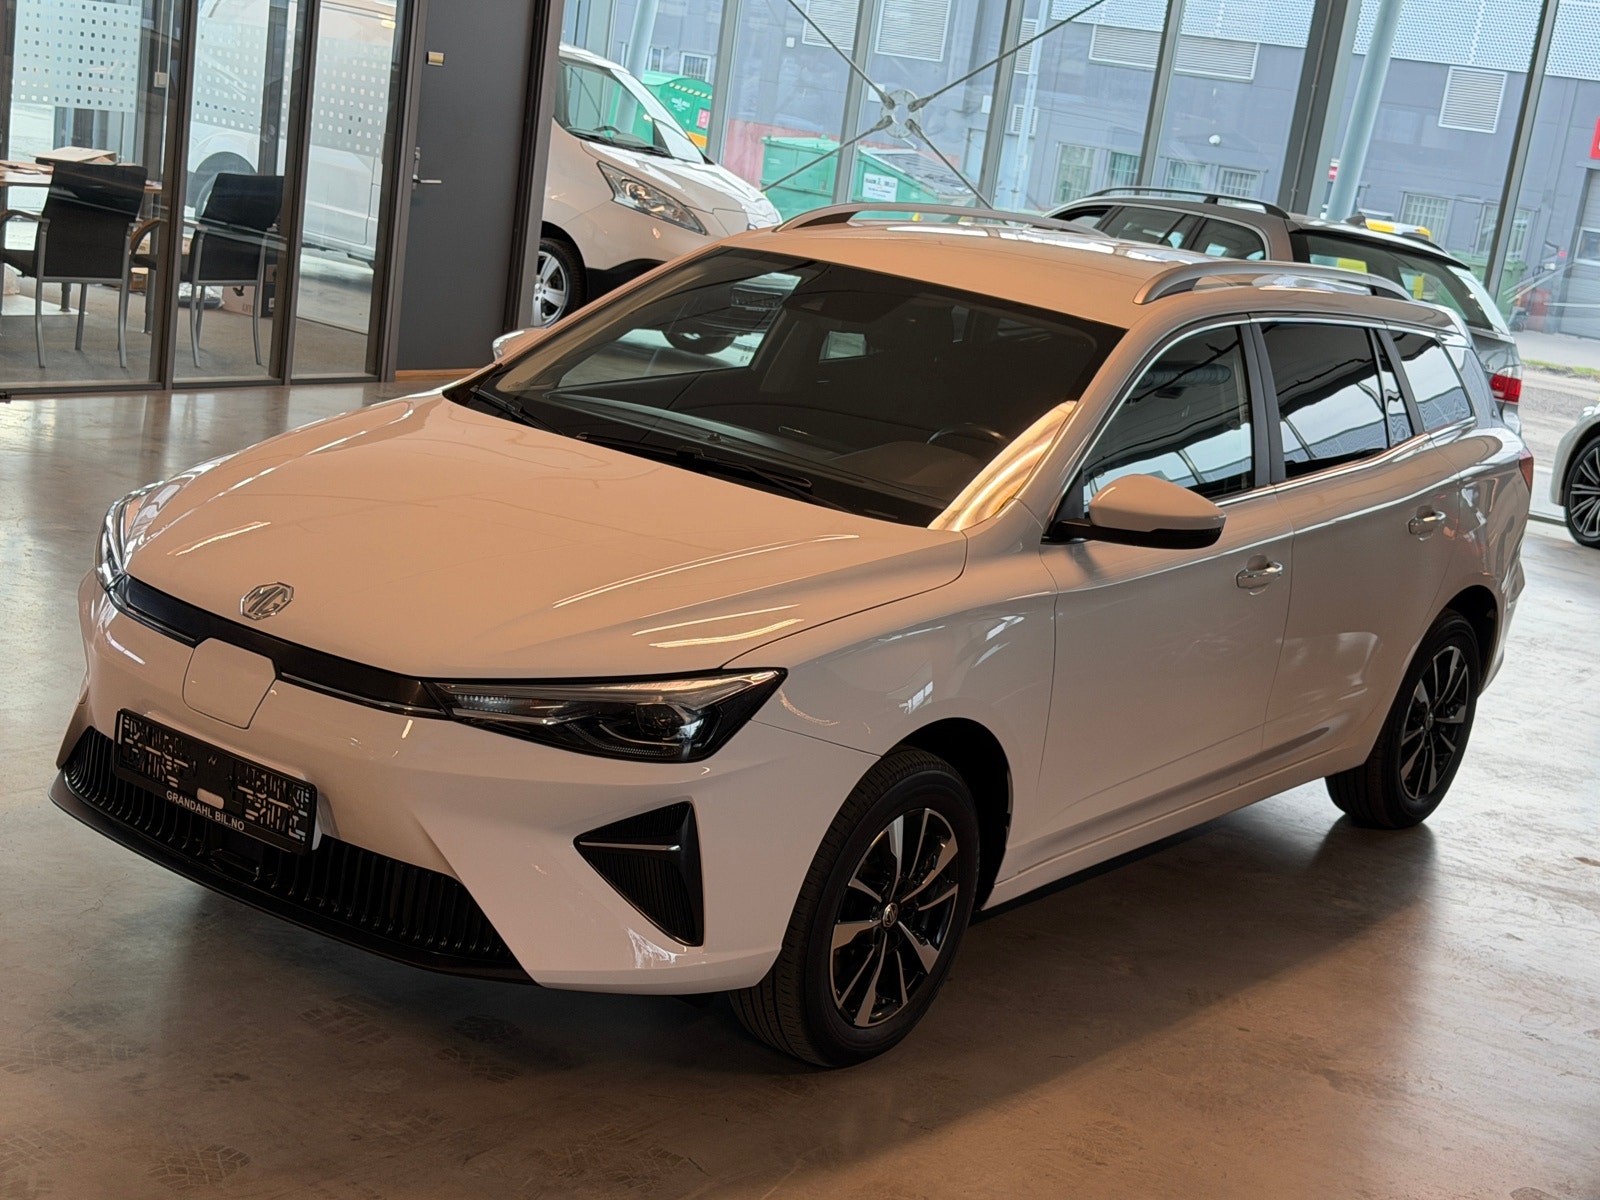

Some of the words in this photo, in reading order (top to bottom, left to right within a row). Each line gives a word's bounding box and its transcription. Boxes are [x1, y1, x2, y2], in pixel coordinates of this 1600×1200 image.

[245, 585, 289, 616] MG
[166, 790, 213, 819] GRANDAHL
[215, 811, 245, 831] BIL.NO
